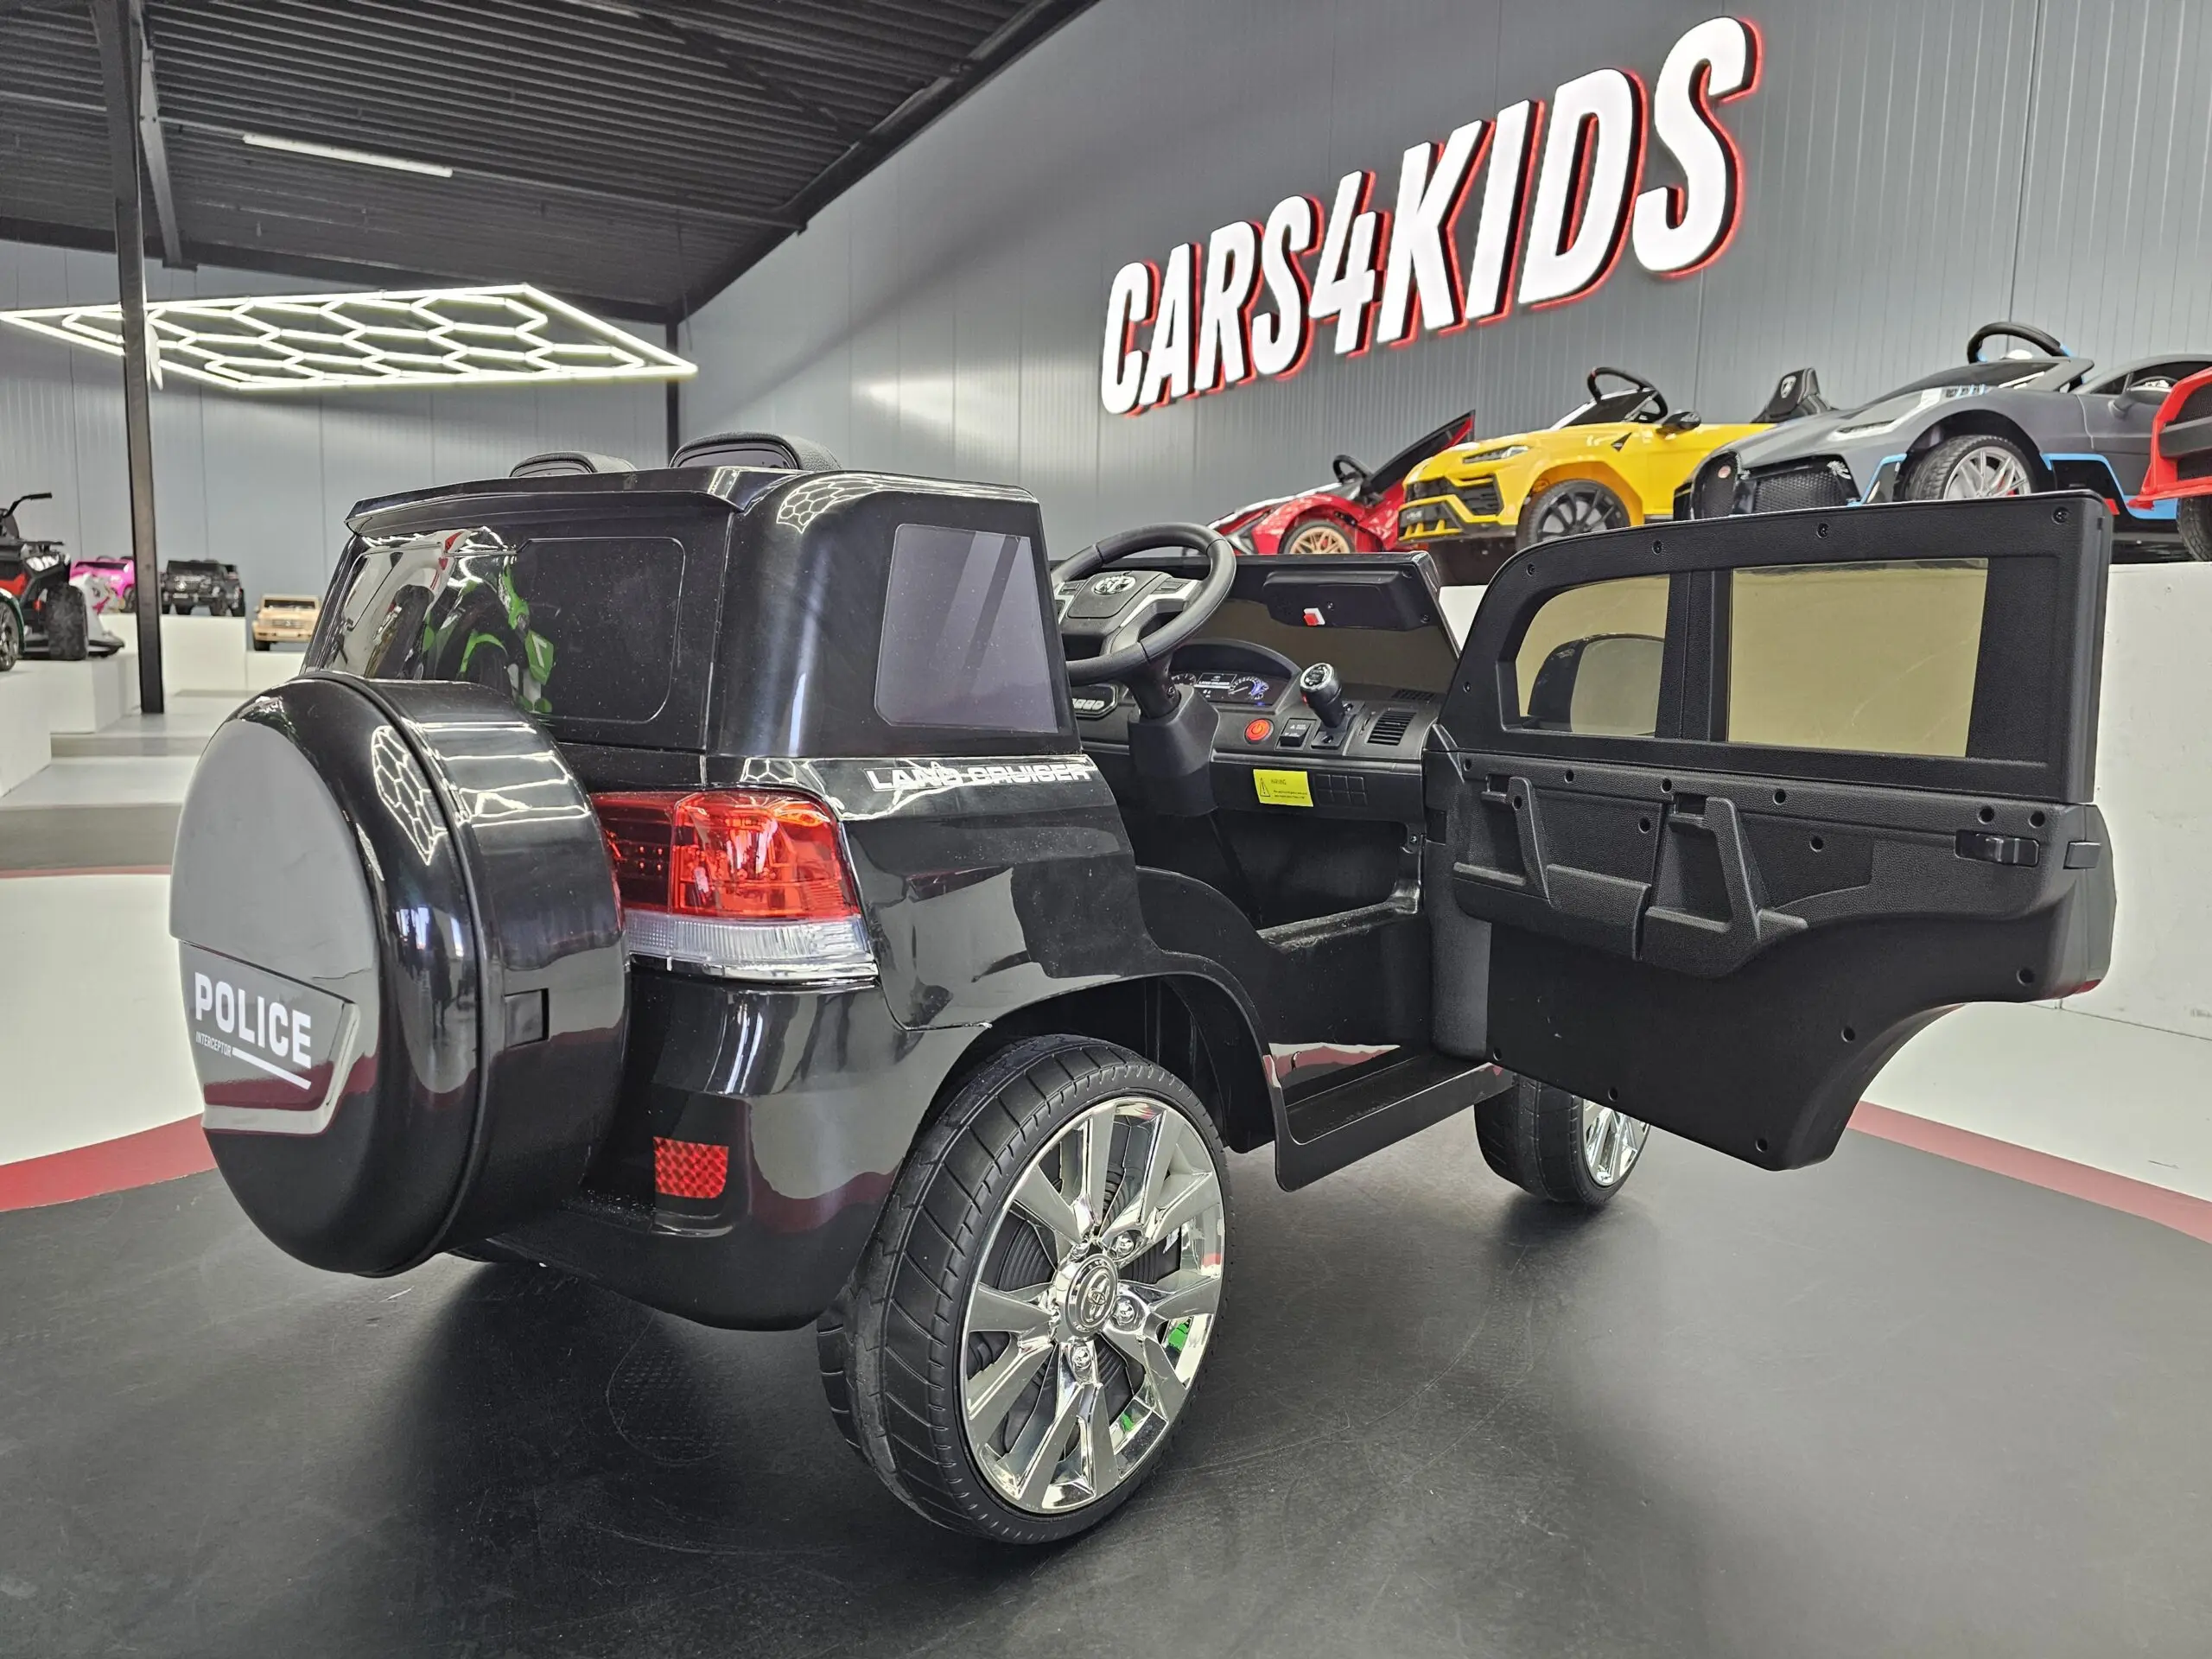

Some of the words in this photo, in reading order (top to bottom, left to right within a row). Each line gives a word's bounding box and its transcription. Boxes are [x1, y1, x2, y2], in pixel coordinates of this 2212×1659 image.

[1100, 16, 1752, 415] CARS4KIDS
[867, 766, 958, 790] LAND
[967, 763, 1090, 785] CRUISER
[194, 971, 312, 1069] POLICE
[195, 1031, 232, 1058] INTERCEPTOR
